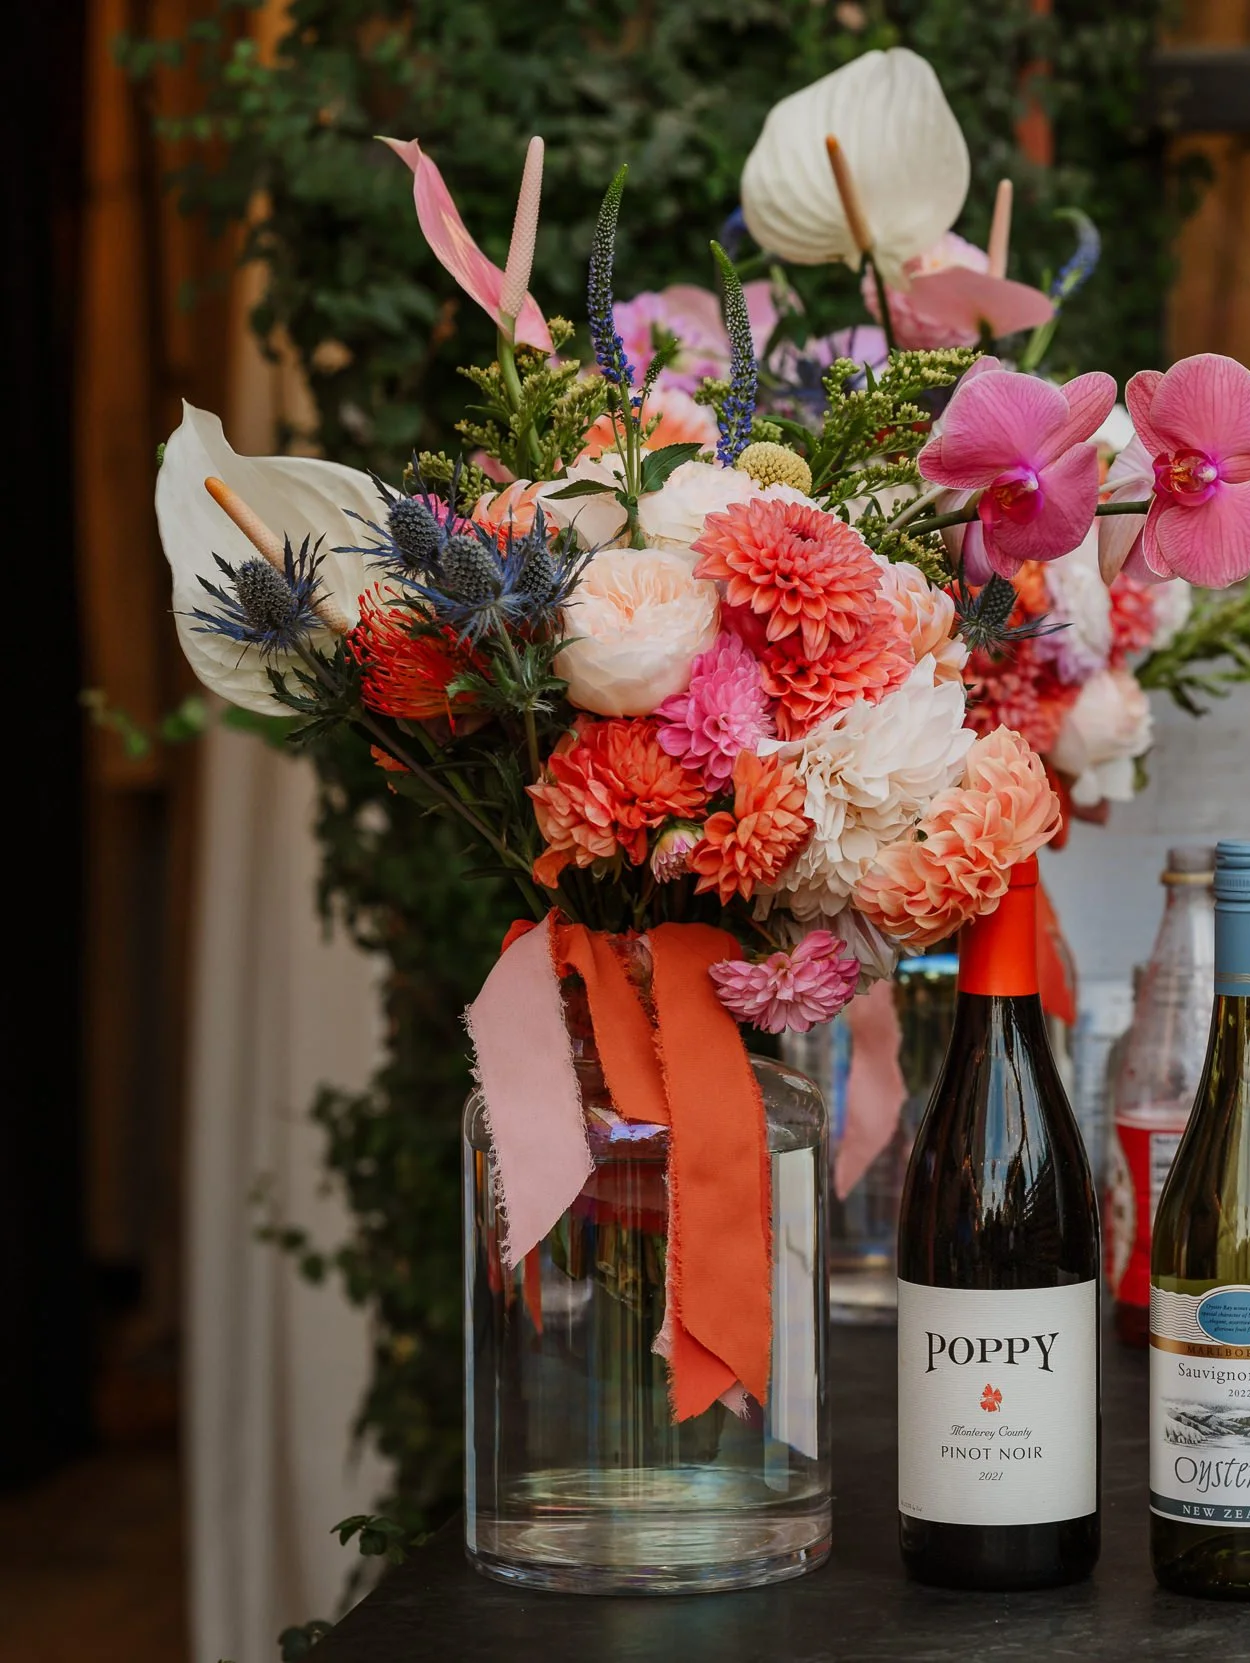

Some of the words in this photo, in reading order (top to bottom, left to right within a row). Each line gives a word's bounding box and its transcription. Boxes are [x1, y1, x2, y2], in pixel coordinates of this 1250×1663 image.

[925, 1332, 1059, 1373] POPPY
[951, 1425, 995, 1440] Monterey
[999, 1426, 1032, 1439] County
[942, 1446, 991, 1460] PINOT
[1000, 1446, 1042, 1460] NOIR
[979, 1472, 1003, 1480] 2021
[1182, 1505, 1214, 1517] NEW
